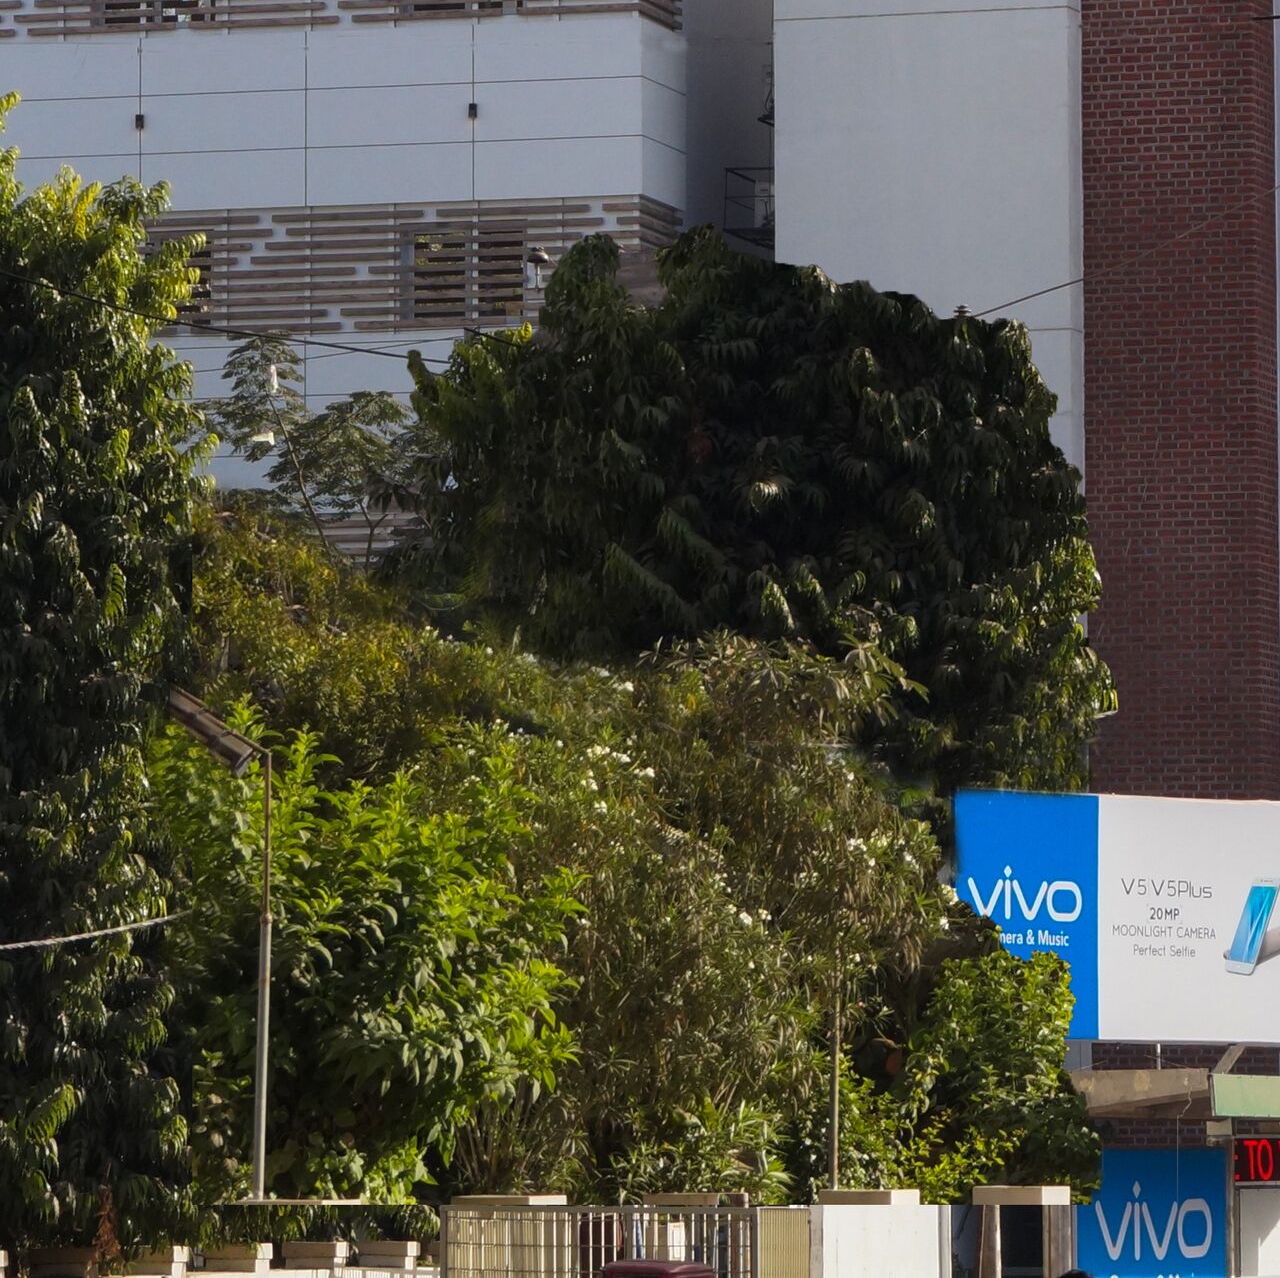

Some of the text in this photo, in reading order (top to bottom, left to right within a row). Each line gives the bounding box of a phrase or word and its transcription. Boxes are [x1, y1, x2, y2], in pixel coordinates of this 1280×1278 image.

[967, 864, 1083, 922] vivo
[1026, 928, 1035, 945] &
[1038, 929, 1070, 947] Music
[1112, 923, 1217, 940] MOONLIGHT CAMERA
[1133, 943, 1197, 958] Perfect Selfie
[1243, 1139, 1274, 1180] TO
[1094, 1180, 1213, 1262] vivo
